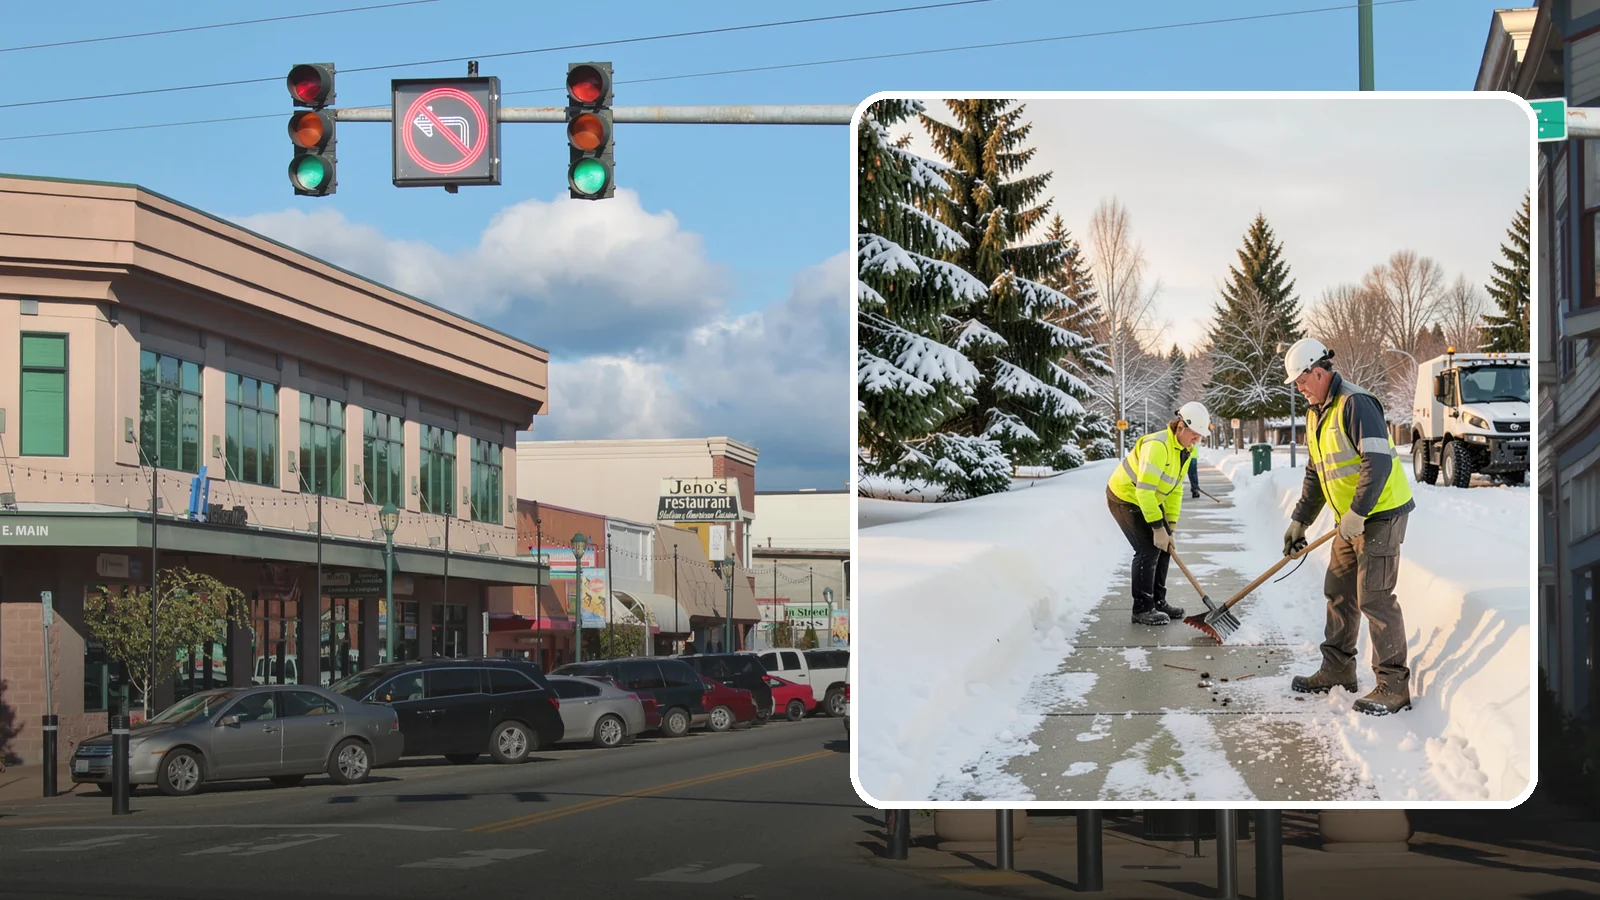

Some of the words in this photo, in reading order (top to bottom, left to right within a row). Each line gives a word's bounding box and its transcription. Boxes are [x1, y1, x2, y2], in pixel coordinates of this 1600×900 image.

[669, 480, 727, 494] Jeno's
[665, 496, 731, 509] restaurant
[686, 509, 714, 519] American
[715, 509, 738, 519] Cuisine
[2, 525, 13, 536] E.
[15, 525, 49, 536] MAIN
[797, 607, 828, 617] Street
